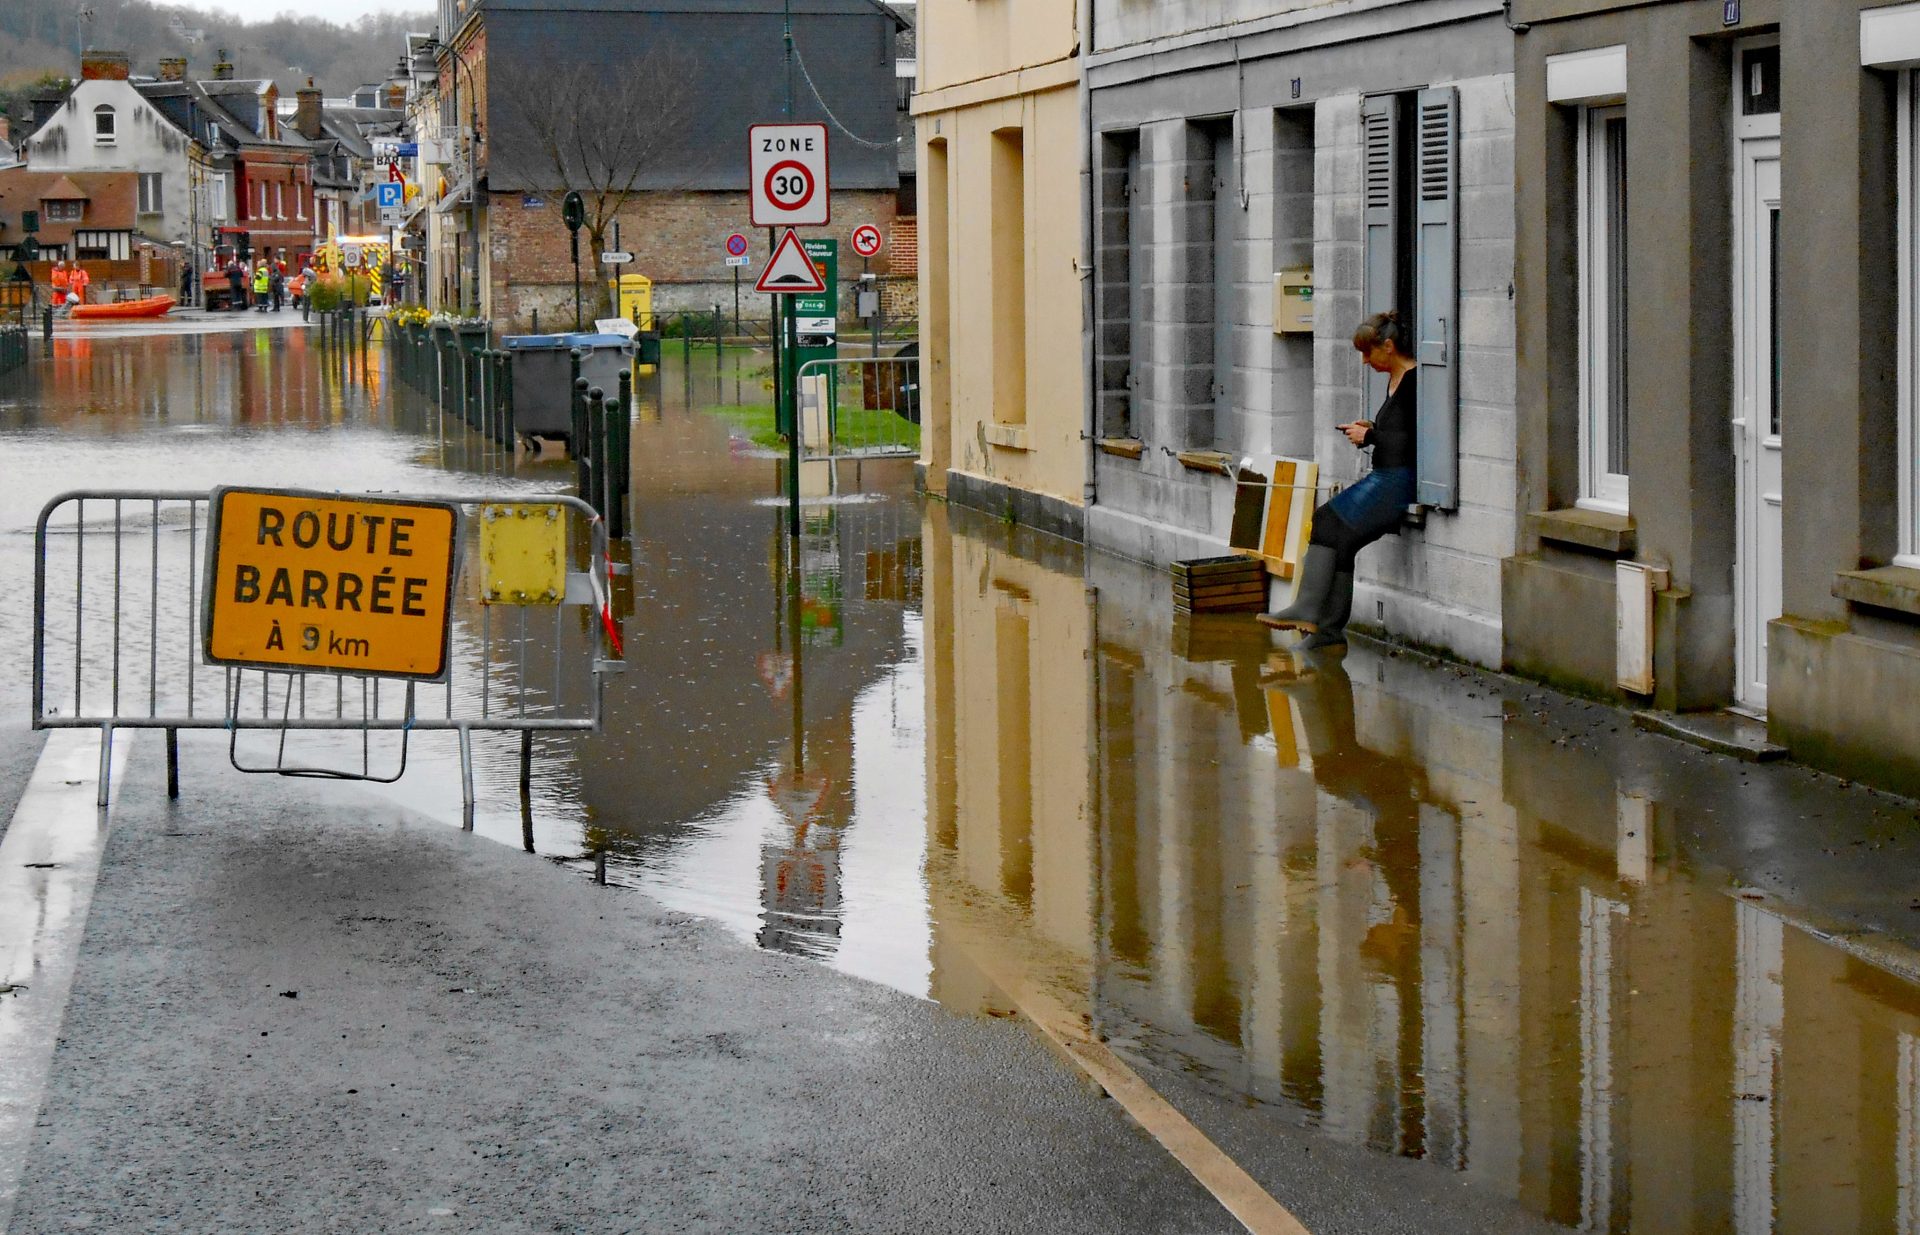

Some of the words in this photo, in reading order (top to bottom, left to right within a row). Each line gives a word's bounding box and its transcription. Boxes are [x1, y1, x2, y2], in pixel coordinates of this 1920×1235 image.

[1727, 4, 1735, 20] 11
[763, 138, 814, 152] ZONE
[376, 156, 399, 166] BAR
[775, 175, 804, 196] 30
[383, 187, 396, 204] P
[257, 507, 415, 557] ROUTE
[234, 564, 428, 617] BARRÉE
[265, 619, 284, 651] À
[301, 626, 320, 651] 9
[328, 630, 370, 657] km
